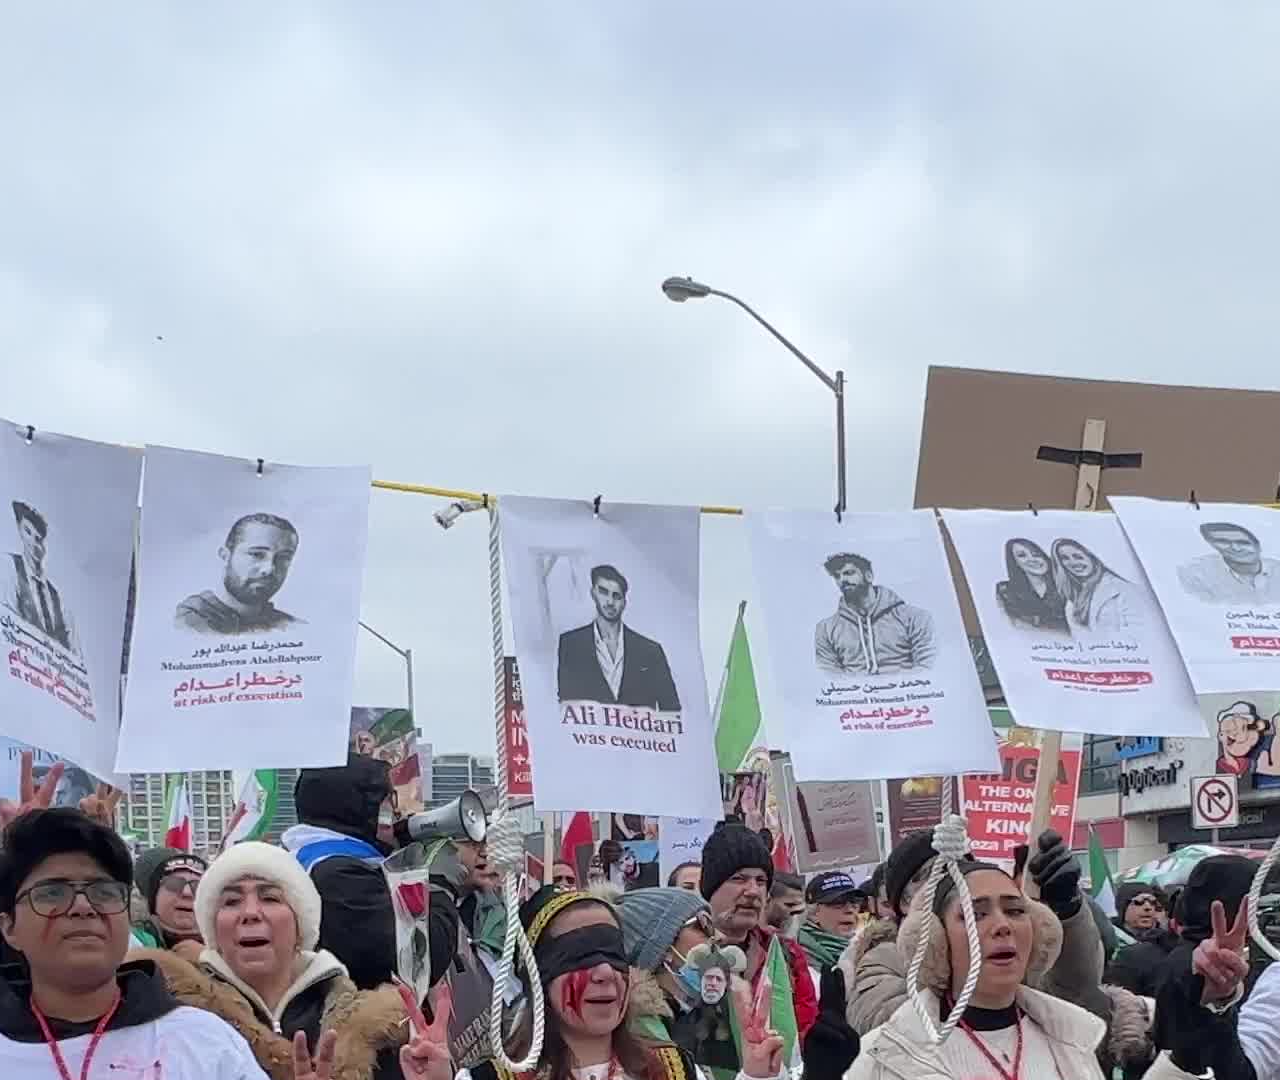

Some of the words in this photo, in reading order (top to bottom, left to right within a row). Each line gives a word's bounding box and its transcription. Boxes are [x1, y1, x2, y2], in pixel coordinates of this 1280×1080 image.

[173, 697, 187, 708] at
[191, 694, 217, 706] risk
[219, 691, 235, 703] of
[235, 688, 304, 702] execution
[561, 704, 597, 725] Ali
[603, 707, 684, 735] Heidari
[572, 732, 606, 746] was
[610, 734, 678, 753] executed
[979, 784, 1011, 798] THE
